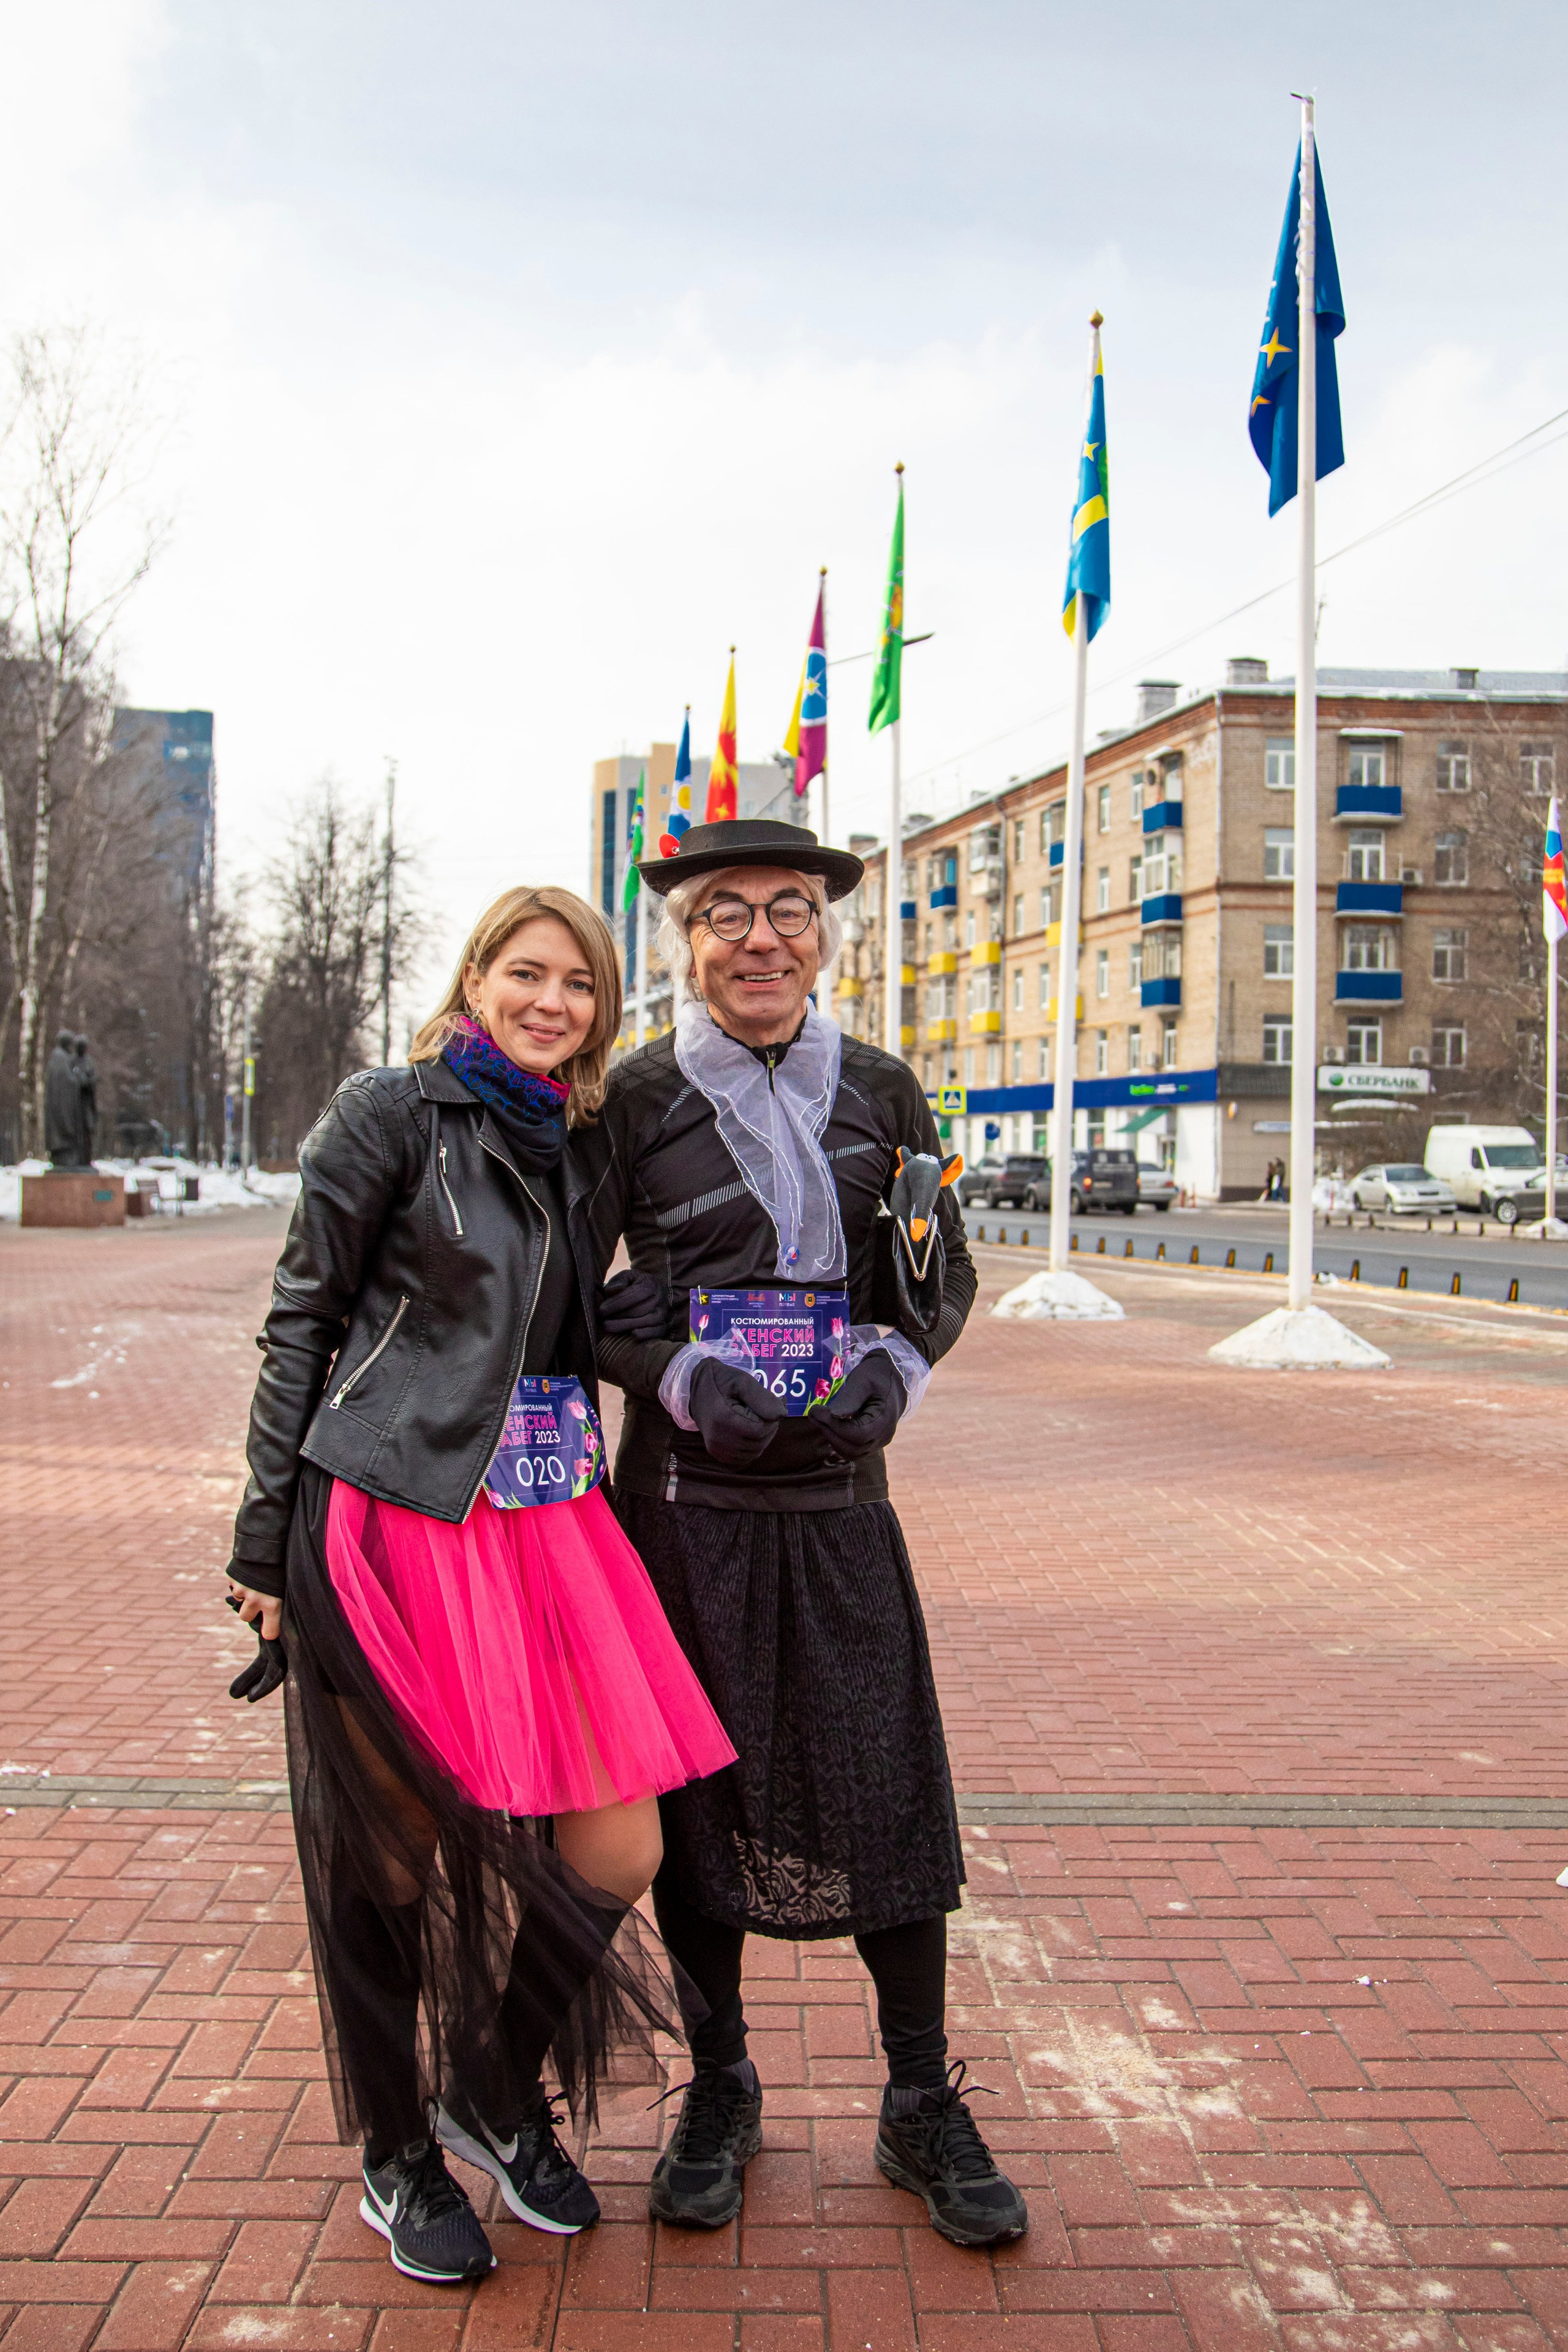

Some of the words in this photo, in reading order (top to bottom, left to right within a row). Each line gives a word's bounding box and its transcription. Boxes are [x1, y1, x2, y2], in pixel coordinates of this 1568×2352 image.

[1348, 1074, 1419, 1088] СБЕРБАНК
[779, 1293, 796, 1302] МЫ
[731, 1325, 815, 1343] ЖЕНСКИЙ
[731, 1344, 777, 1357] ЗАБЕГ
[781, 1343, 814, 1357] 2023
[524, 1379, 537, 1387] МЫ
[535, 1430, 561, 1444] 2023
[516, 1455, 566, 1487] 020
